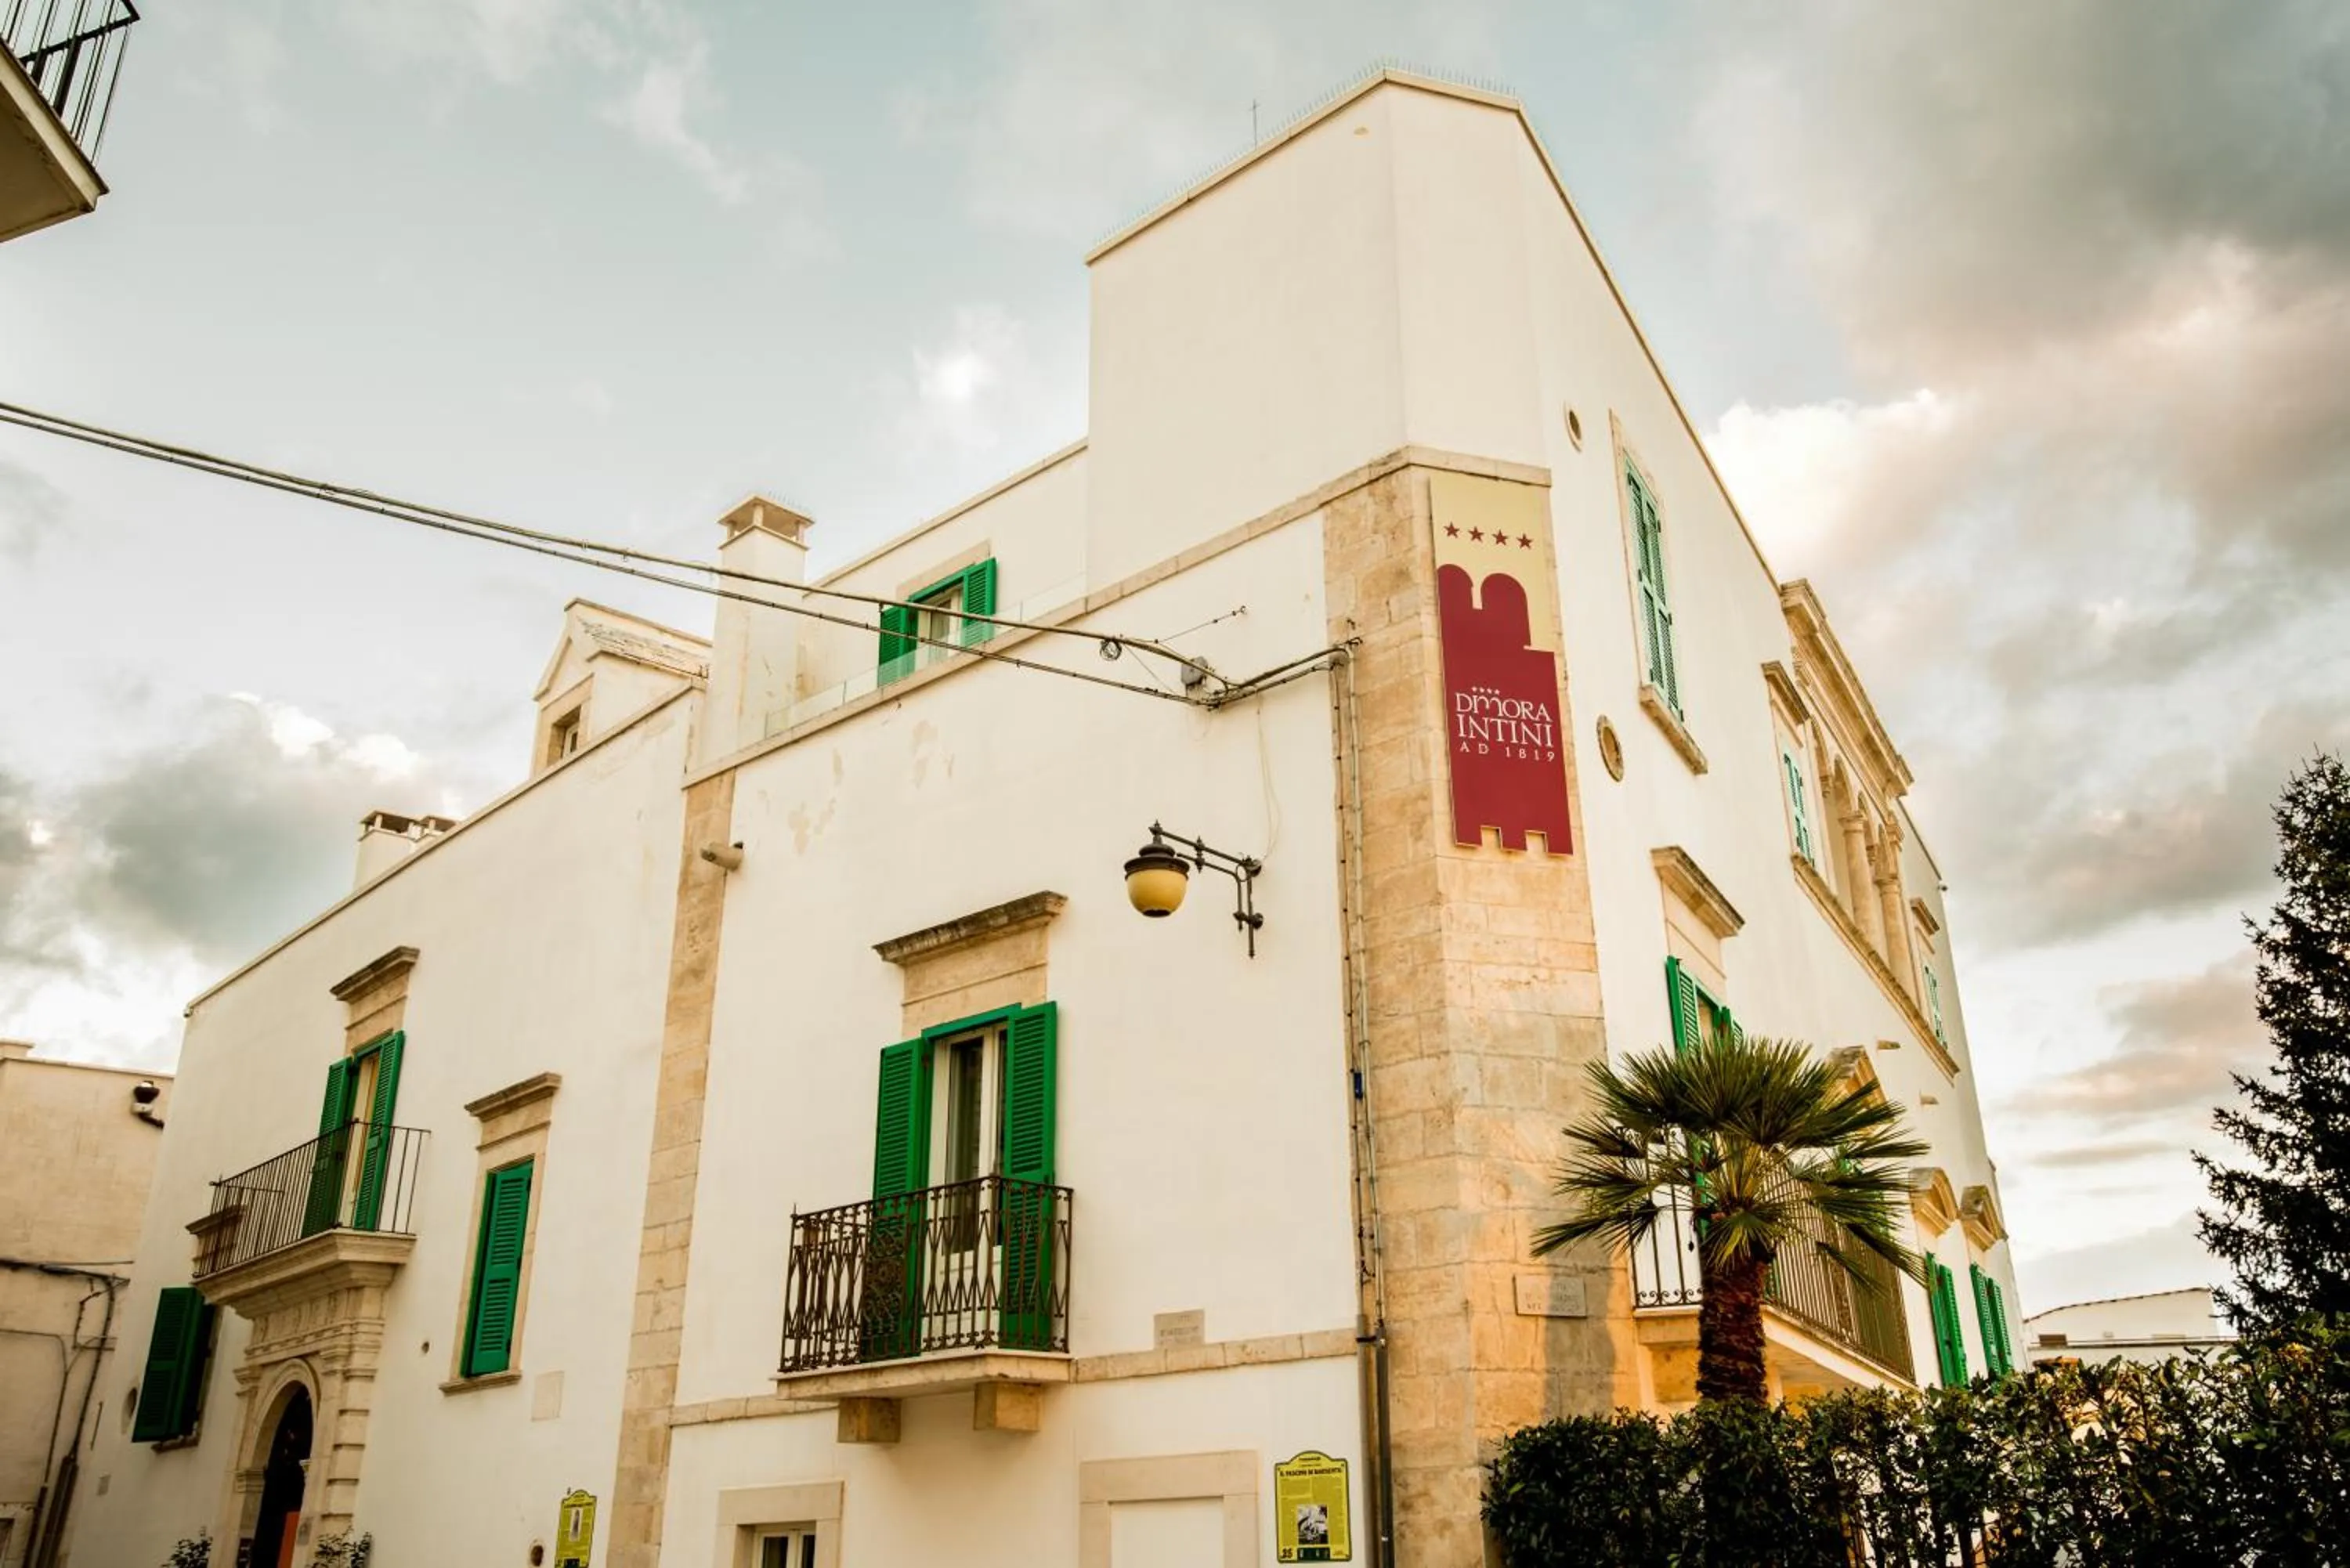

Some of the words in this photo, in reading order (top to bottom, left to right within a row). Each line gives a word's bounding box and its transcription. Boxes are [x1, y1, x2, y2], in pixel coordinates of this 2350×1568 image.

[1455, 692, 1553, 722] DIMORA
[1456, 714, 1554, 748] INTINI
[1459, 741, 1489, 755] AD
[1505, 746, 1555, 762] 1819
